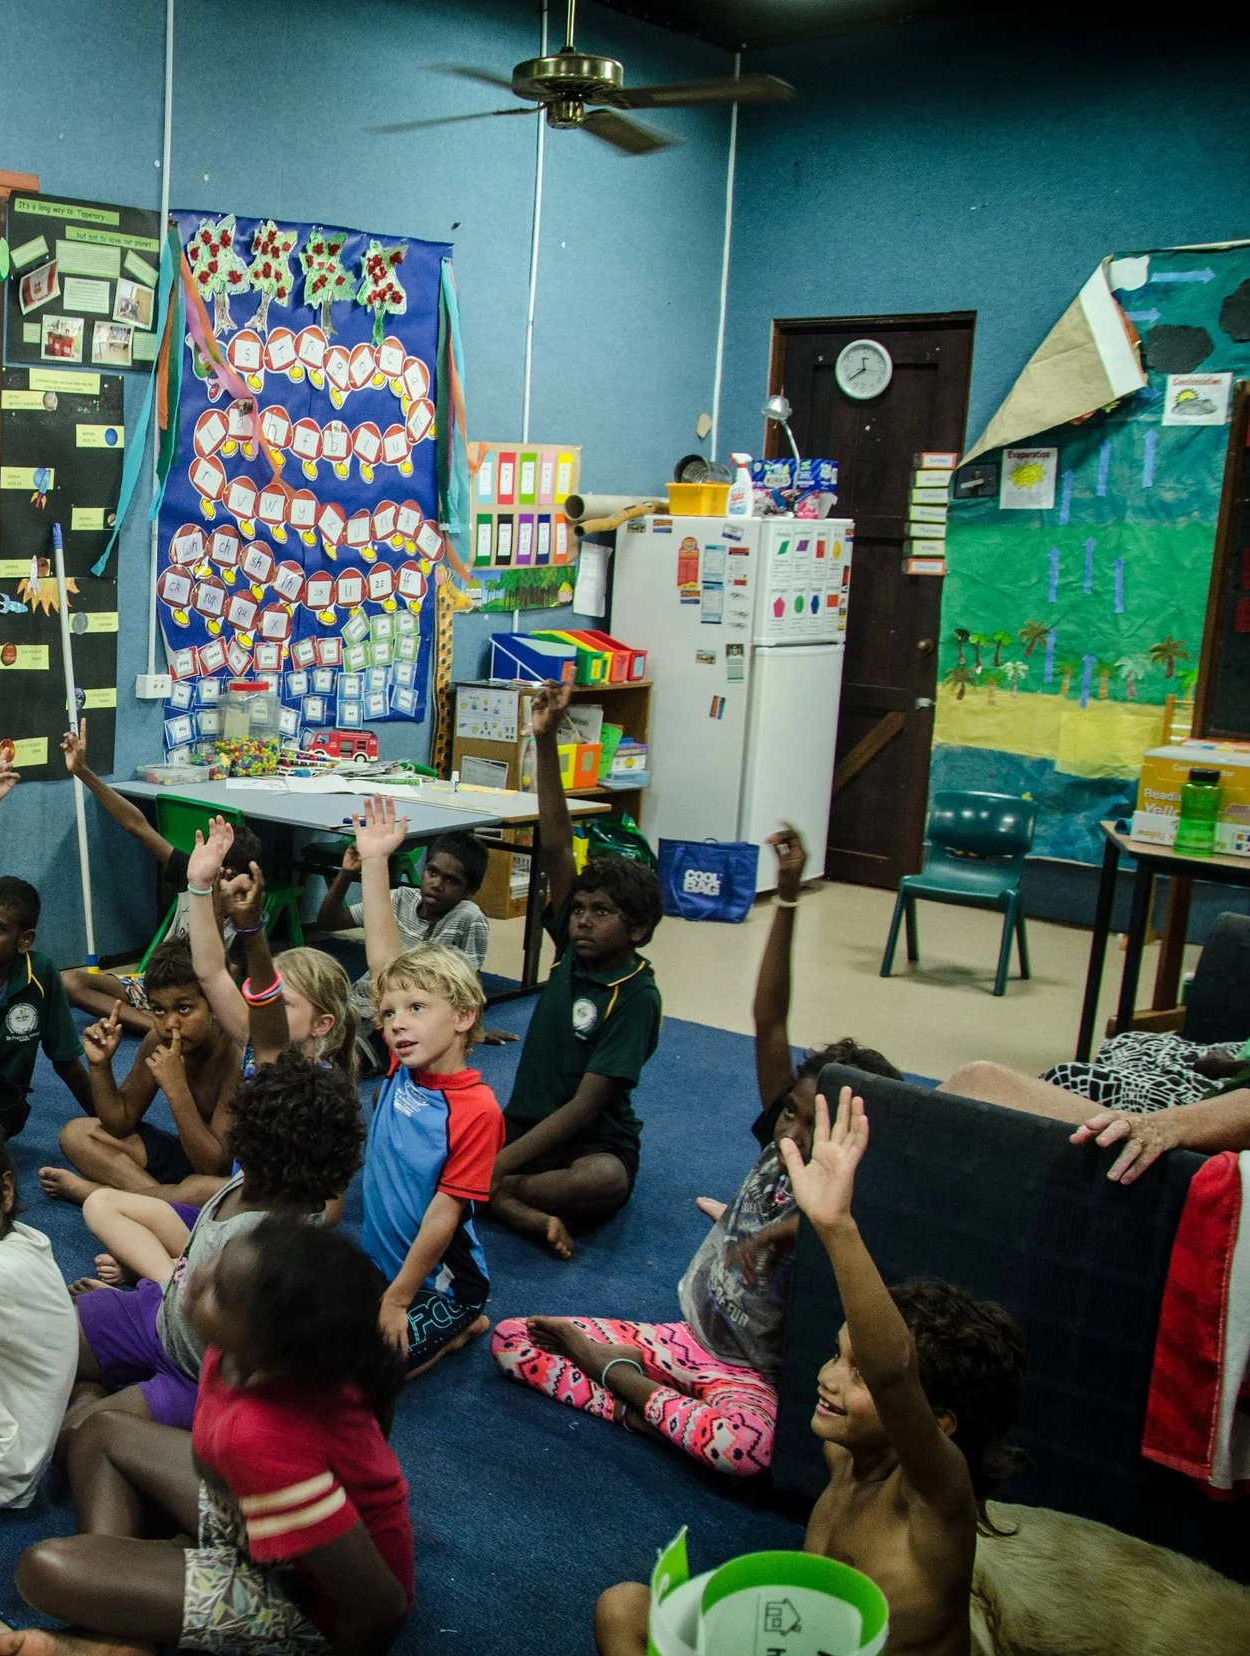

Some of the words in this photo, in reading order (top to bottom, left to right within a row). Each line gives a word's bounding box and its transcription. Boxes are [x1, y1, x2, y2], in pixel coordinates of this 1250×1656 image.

[18, 200, 31, 209] It's
[38, 204, 51, 214] long
[76, 231, 87, 240] but
[108, 237, 121, 245] save
[1007, 451, 1050, 460] Evaporation
[219, 539, 230, 555] ch
[249, 555, 262, 570] sh
[168, 581, 181, 593] ck
[374, 579, 385, 589] zz
[402, 572, 412, 588] ff
[313, 588, 324, 597] ss
[344, 585, 353, 597] ll
[203, 591, 216, 610] ng
[1144, 788, 1181, 801] Readi
[685, 870, 719, 881] COOL
[683, 880, 721, 896] BAG
[727, 1303, 750, 1328] FUN
